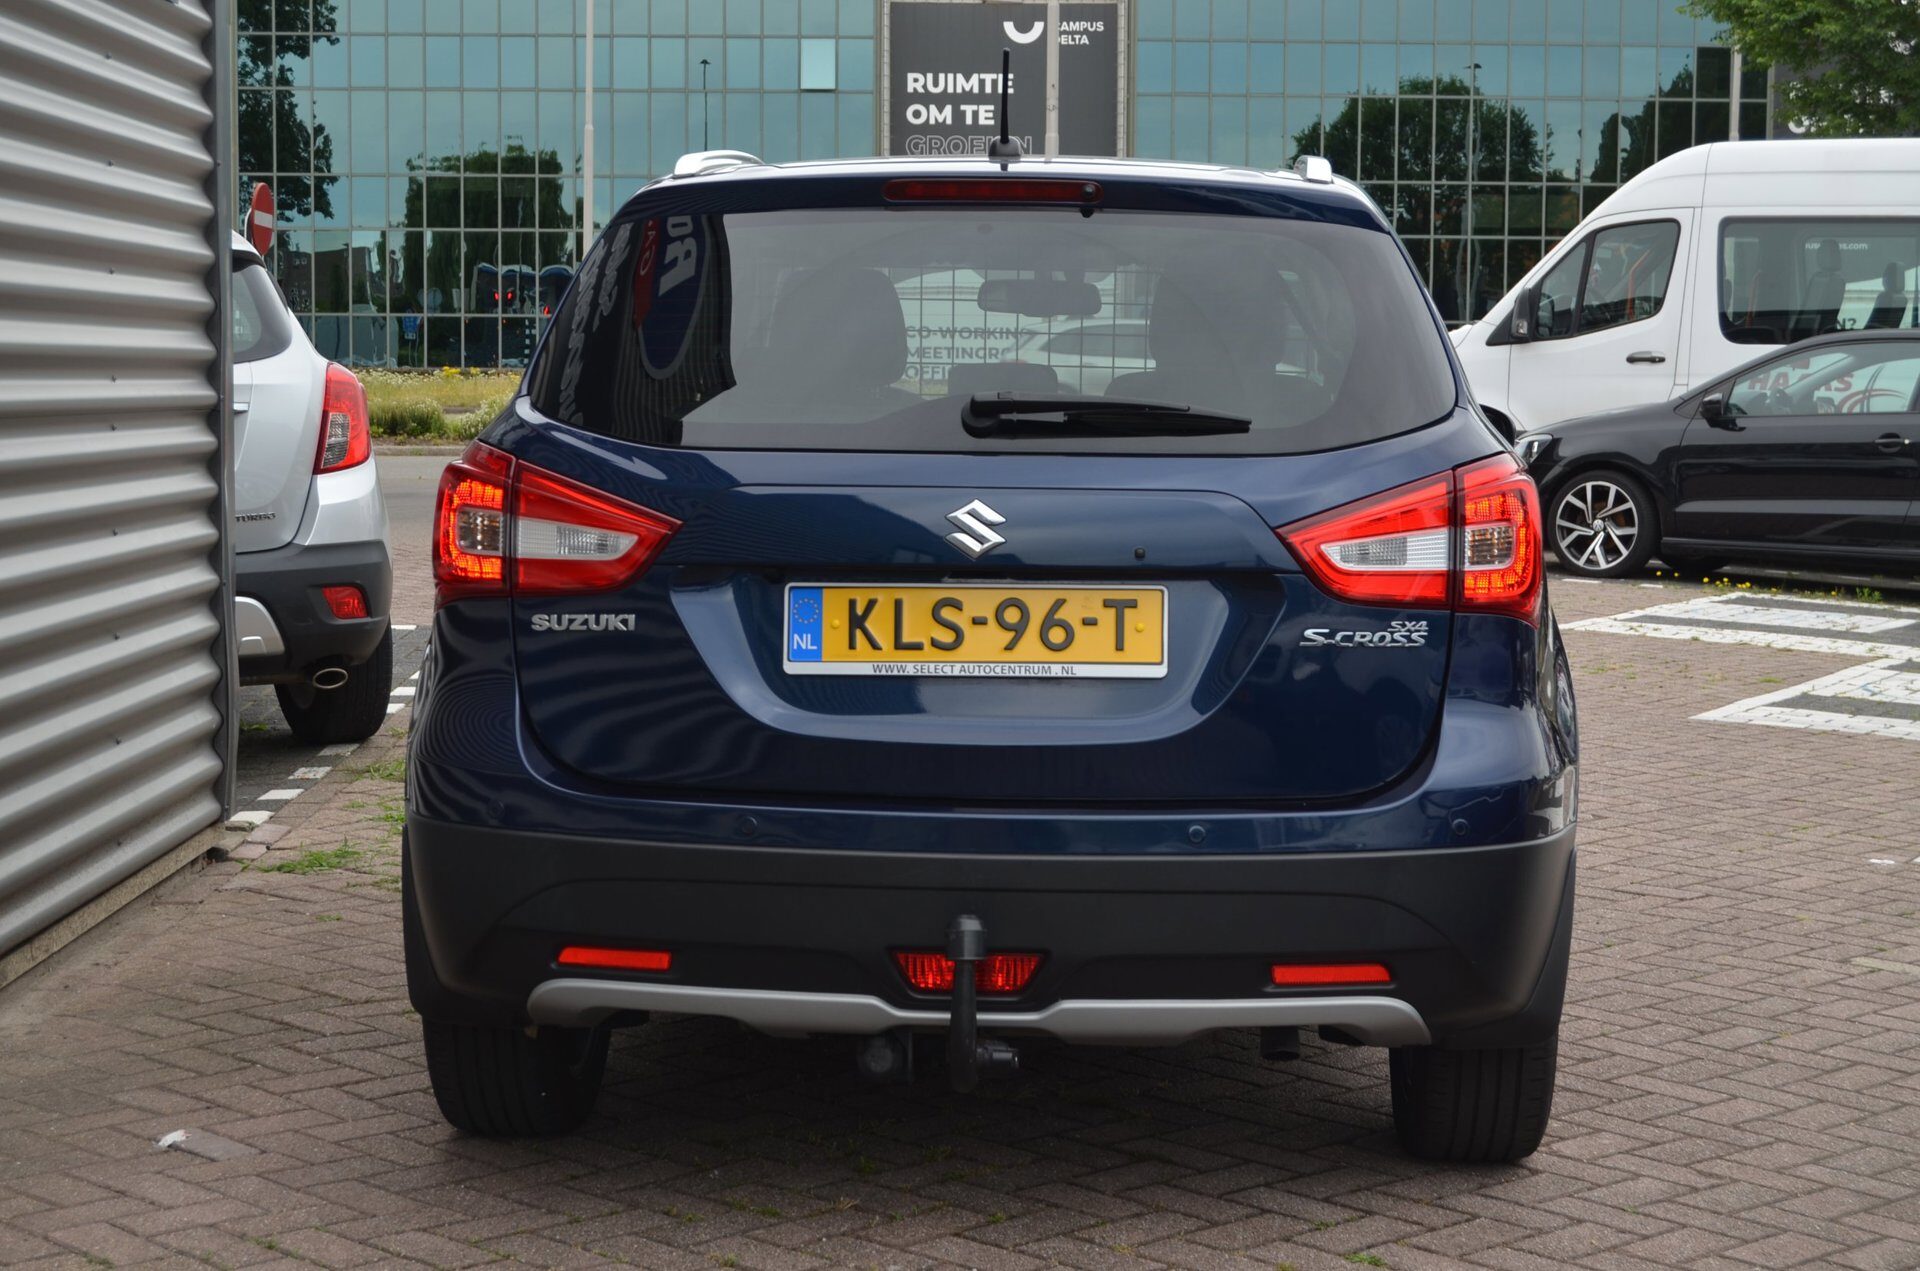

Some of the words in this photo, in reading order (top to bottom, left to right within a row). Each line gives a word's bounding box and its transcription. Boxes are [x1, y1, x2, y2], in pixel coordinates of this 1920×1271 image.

[1058, 21, 1104, 32] AMPUS
[1058, 34, 1090, 45] ELTA
[906, 72, 1015, 94] RUIMTE
[906, 104, 952, 125] OM
[960, 104, 995, 125] TE
[905, 135, 1033, 155] GROEIN
[904, 365, 949, 379] OFFI
[531, 613, 636, 631] SUZUKI
[848, 597, 1138, 652] KLS-96-T
[1387, 620, 1429, 632] SX4
[793, 633, 818, 650] NL
[1299, 628, 1429, 647] S-CROSS
